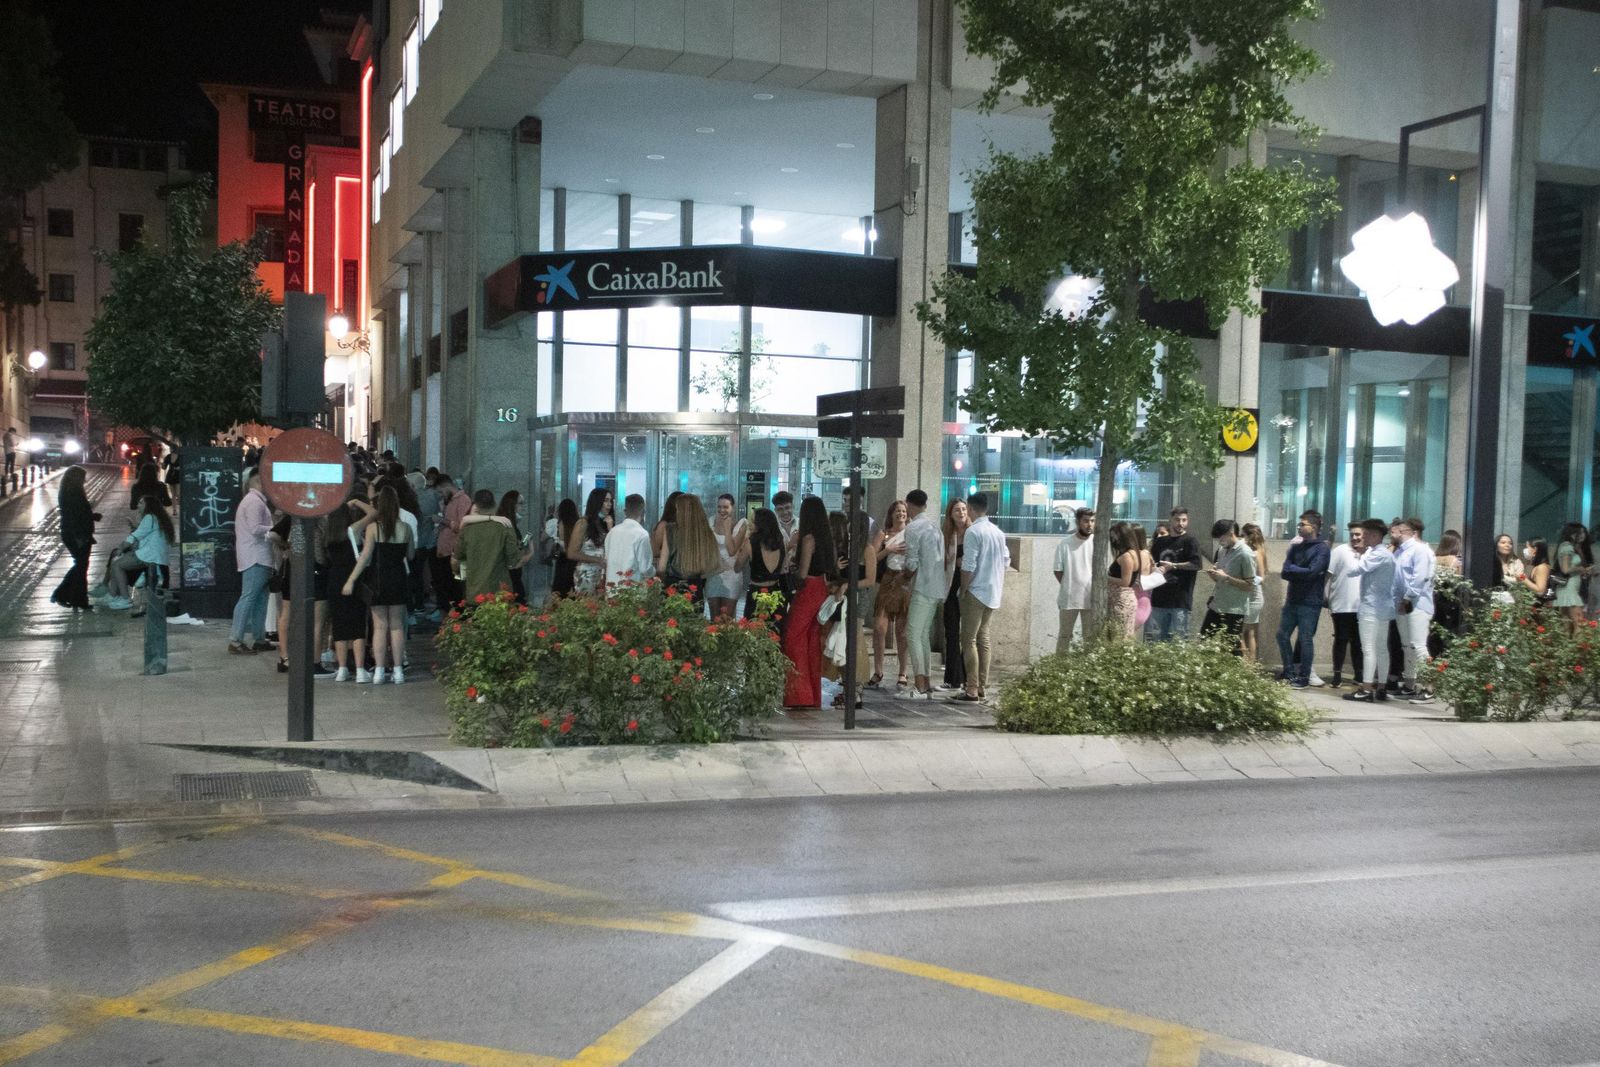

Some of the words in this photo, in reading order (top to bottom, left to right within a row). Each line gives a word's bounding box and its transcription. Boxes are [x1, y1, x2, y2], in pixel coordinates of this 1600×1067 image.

[254, 99, 337, 121] TEATRO
[288, 145, 302, 285] GRANADA
[587, 259, 724, 291] CaixaBank
[496, 407, 518, 423] 16
